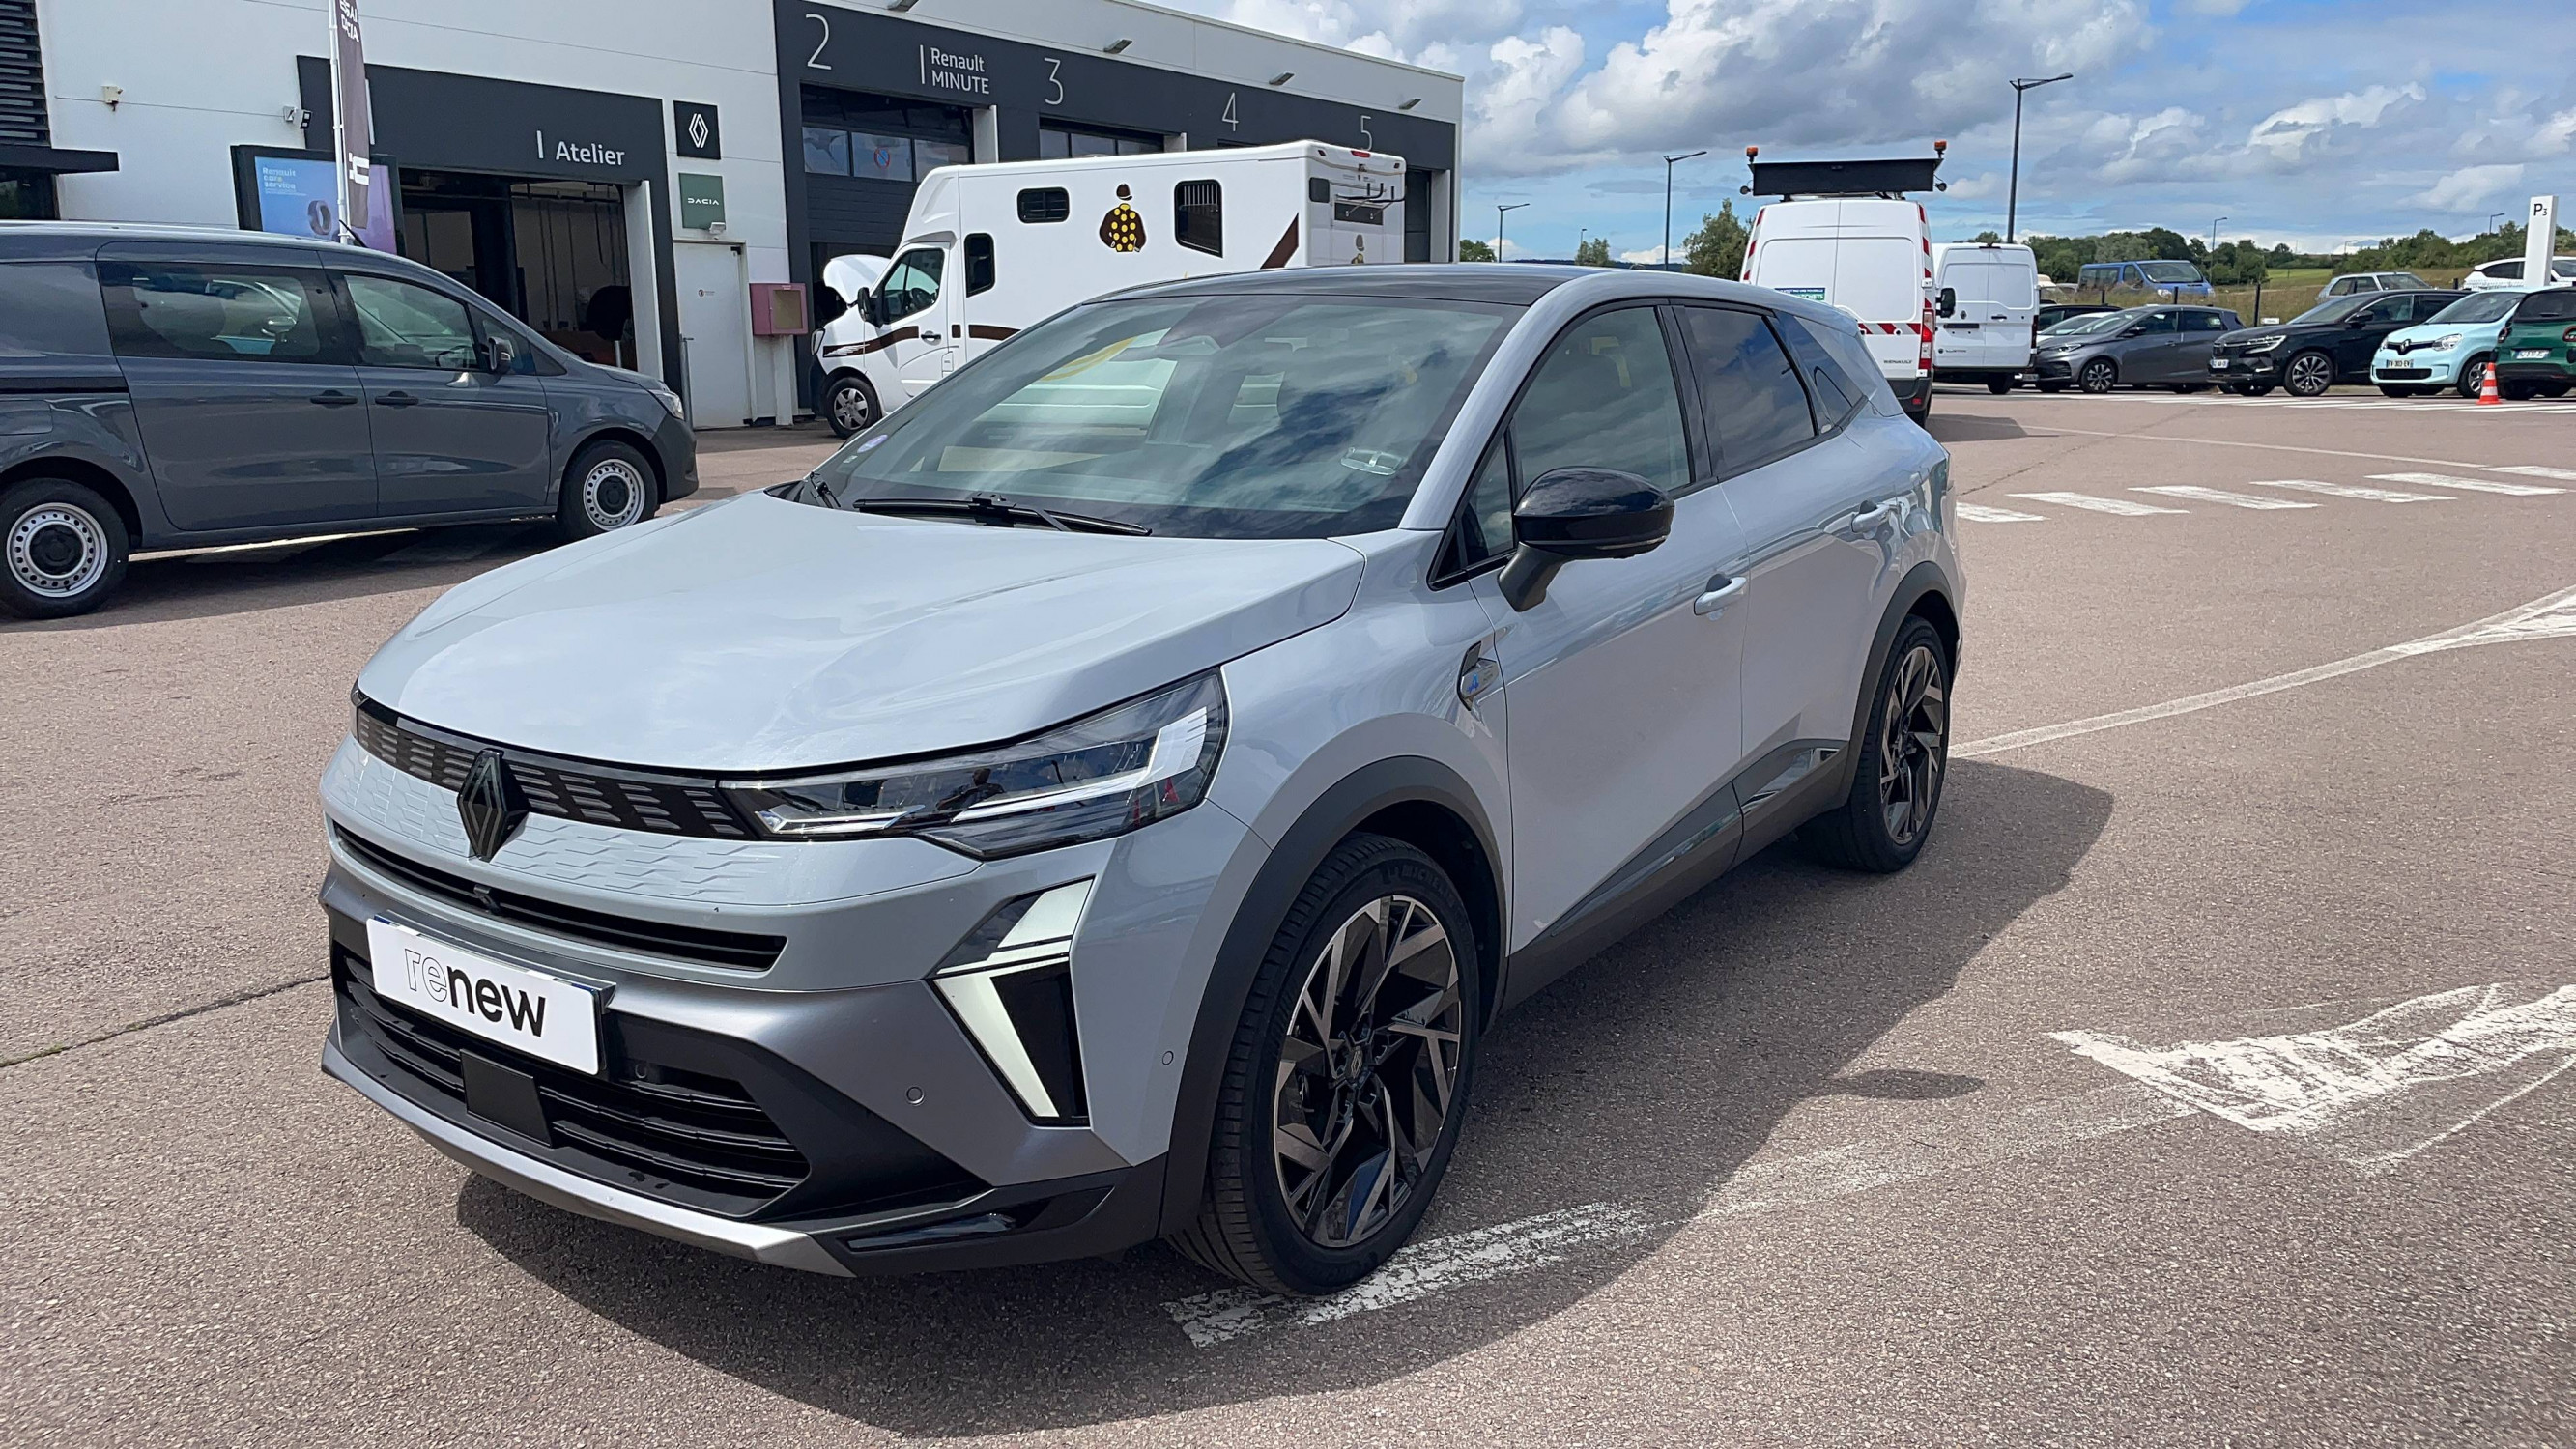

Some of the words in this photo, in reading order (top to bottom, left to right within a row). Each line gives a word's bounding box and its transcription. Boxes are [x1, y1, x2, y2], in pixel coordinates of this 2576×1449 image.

[805, 13, 832, 71] 2
[930, 47, 986, 72] Renault
[931, 70, 990, 95] MINUTE
[1044, 57, 1064, 105] 3
[1221, 92, 1239, 132] 4
[1360, 115, 1373, 152] 5
[555, 141, 626, 166] Atelier
[687, 197, 720, 206] DACIA
[404, 948, 547, 1038] renew
